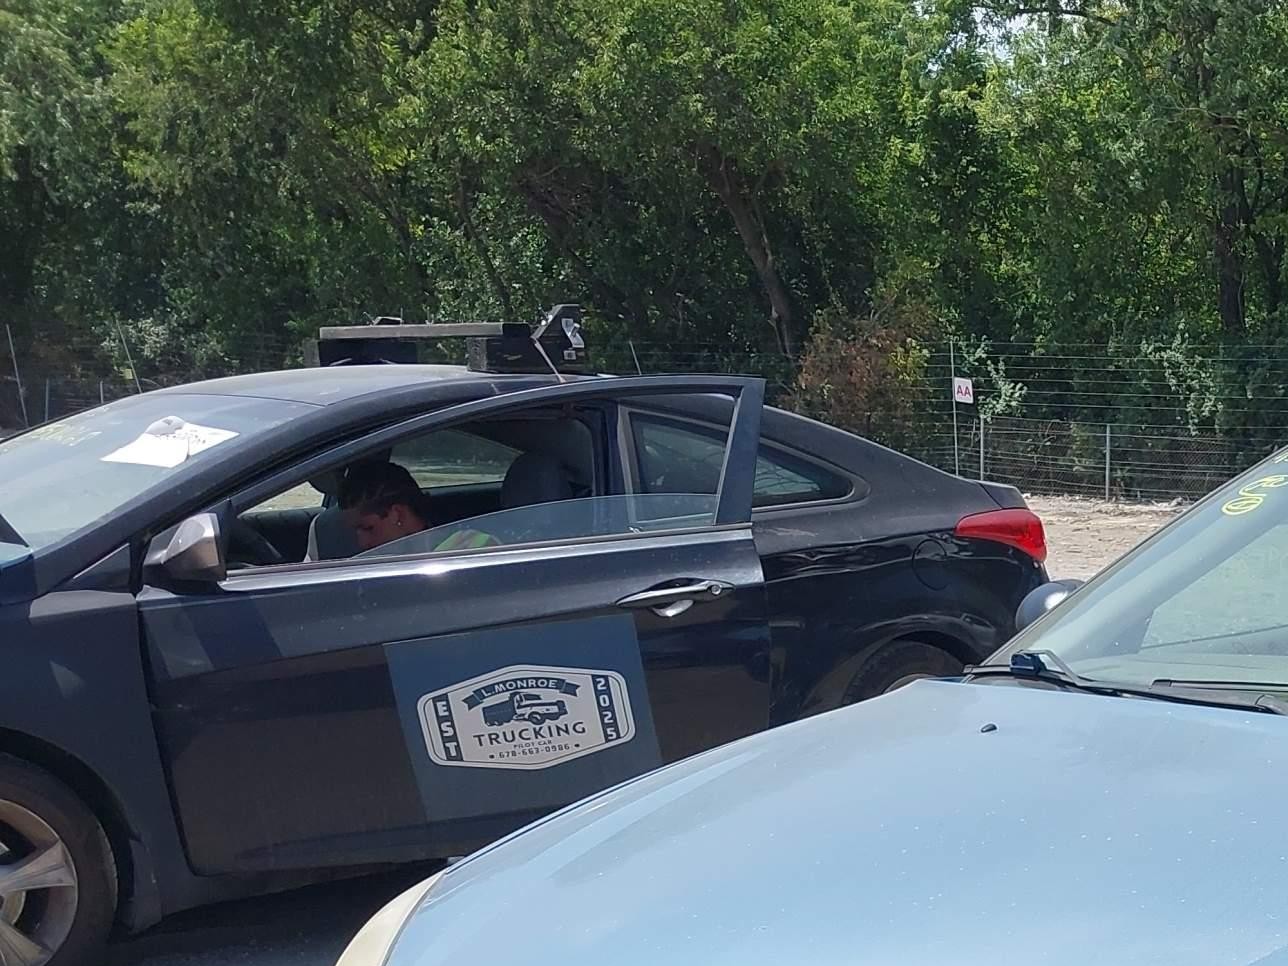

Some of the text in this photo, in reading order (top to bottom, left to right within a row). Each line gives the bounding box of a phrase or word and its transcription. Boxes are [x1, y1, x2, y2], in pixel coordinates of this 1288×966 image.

[956, 385, 972, 398] AA
[481, 678, 558, 697] L.MONROE
[595, 678, 618, 741] 2025
[436, 700, 458, 757] EST
[473, 721, 587, 748] TRUCKING
